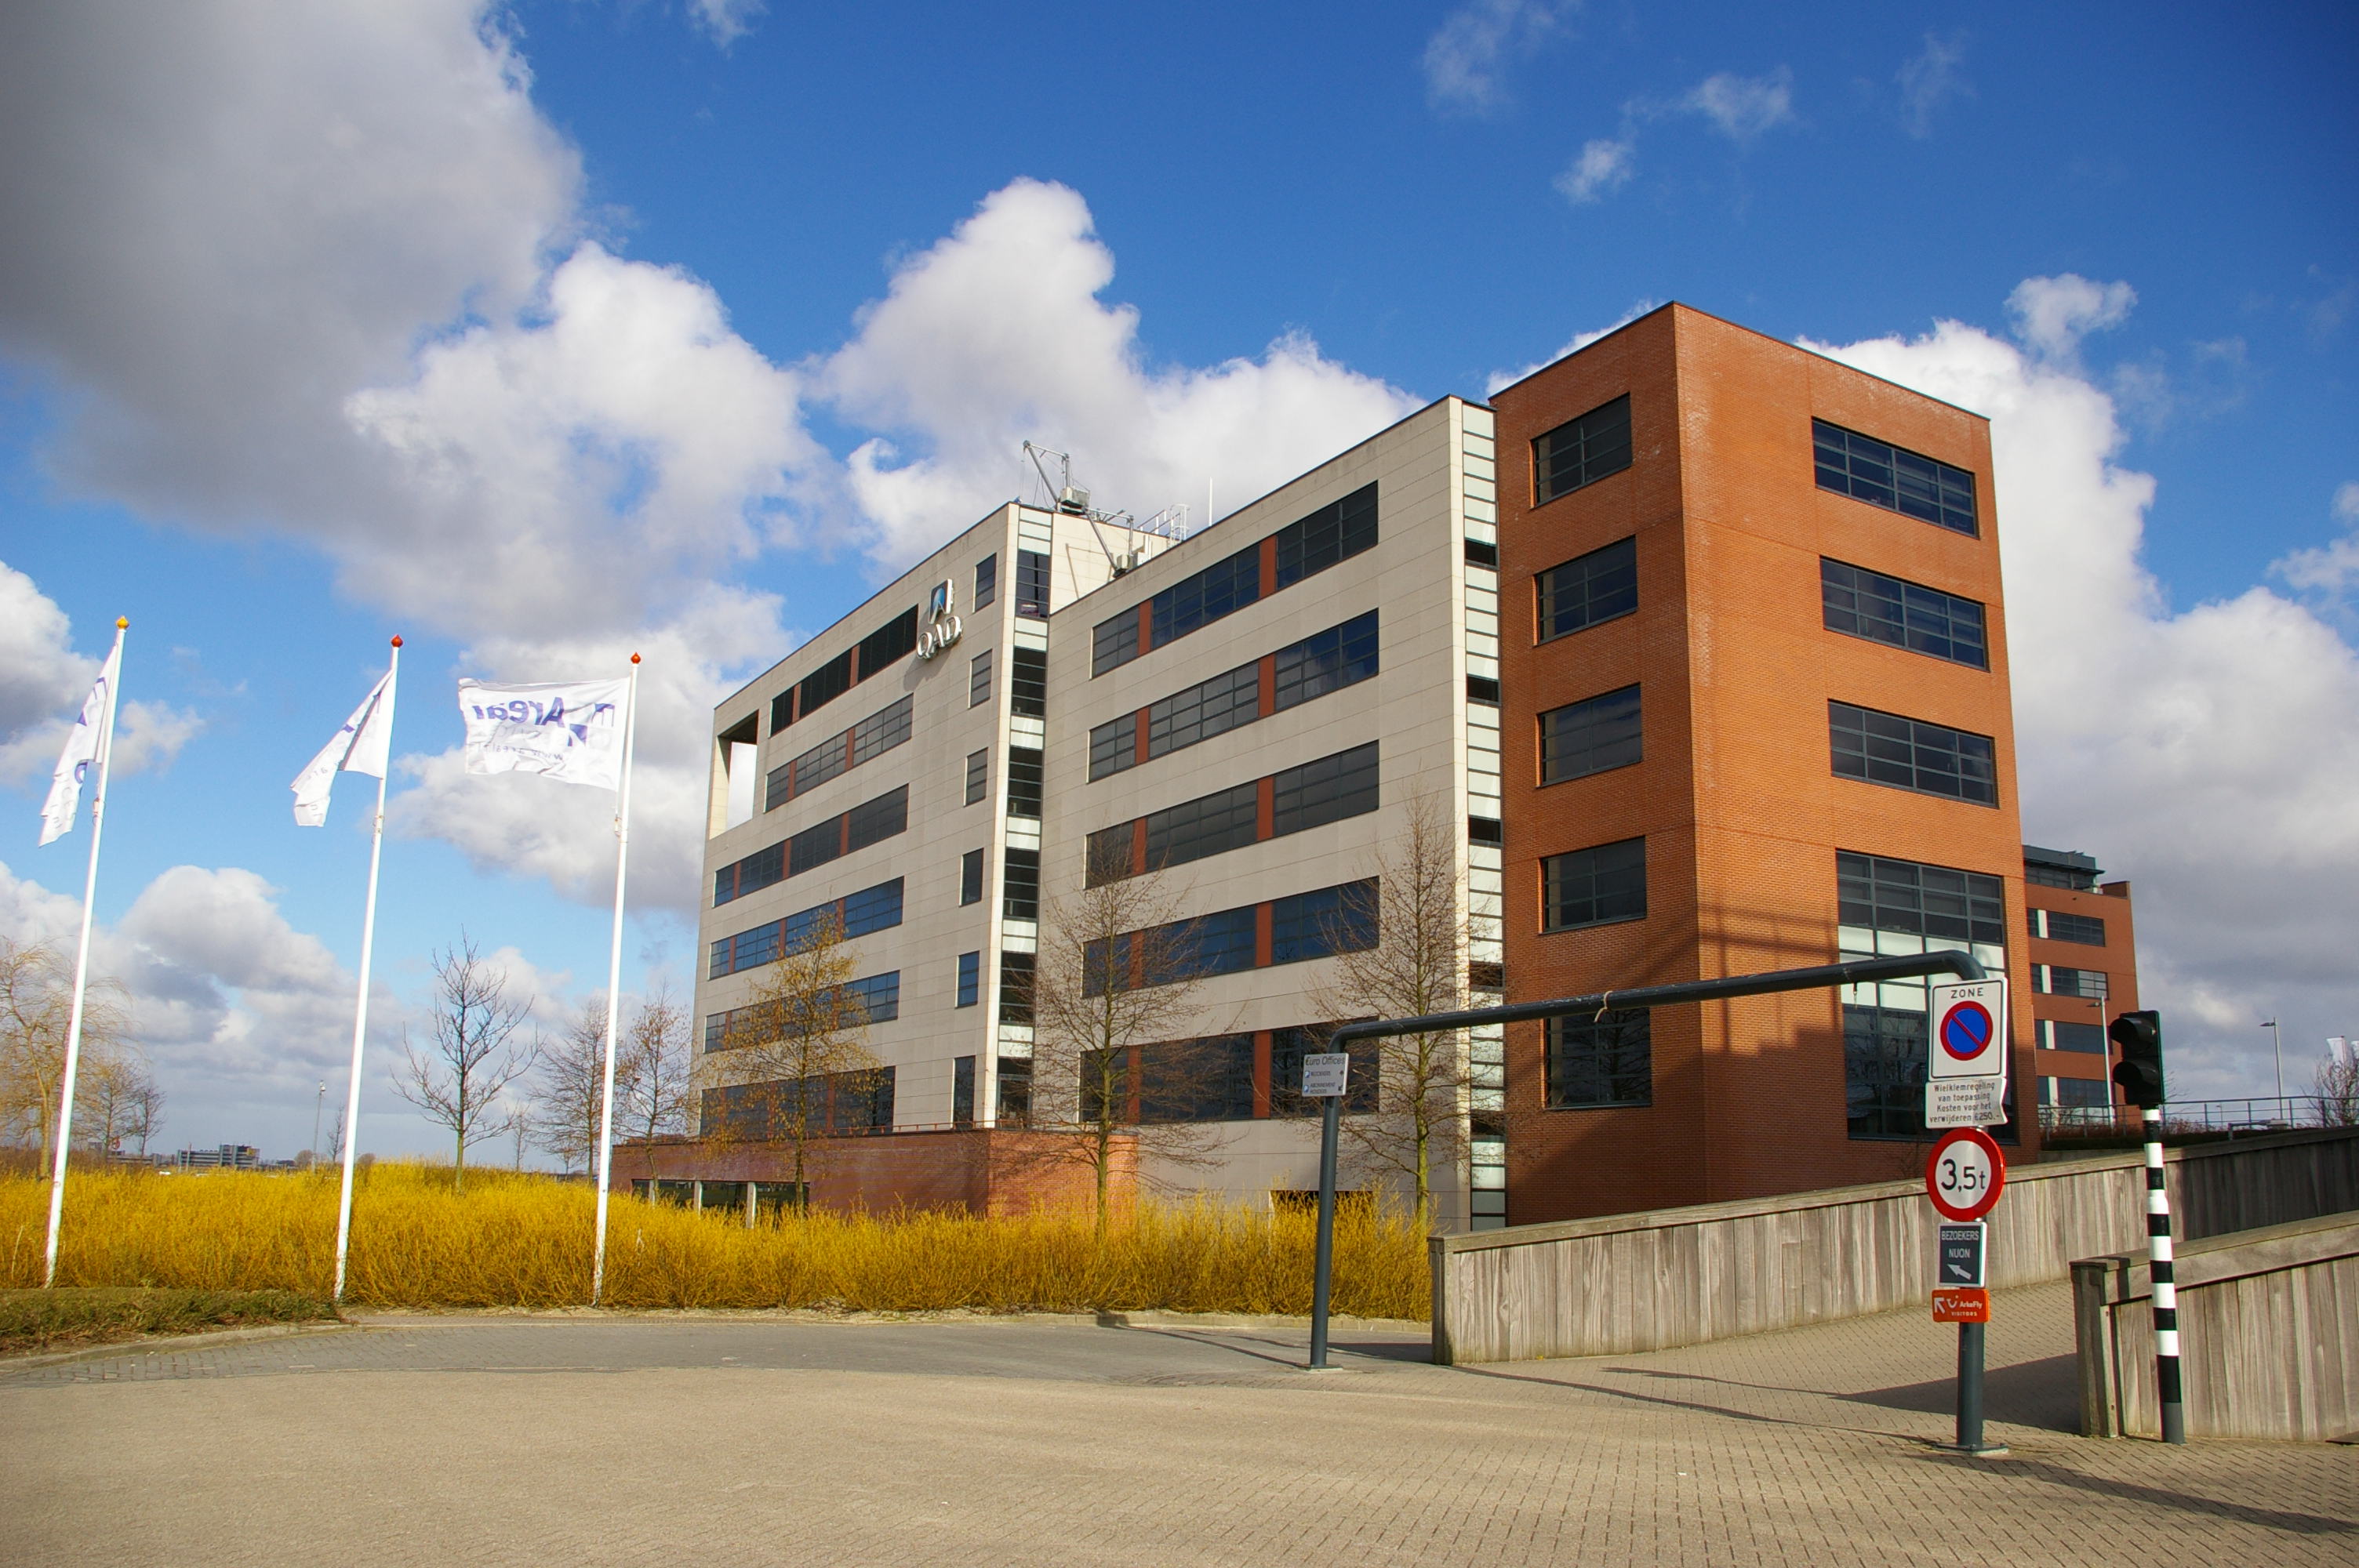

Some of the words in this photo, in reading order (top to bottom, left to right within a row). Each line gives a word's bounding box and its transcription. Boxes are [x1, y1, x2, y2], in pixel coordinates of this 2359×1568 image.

[918, 615, 963, 659] QAD
[1950, 987, 1983, 999] ZONE
[1934, 1082, 1995, 1093] Wielklemregeling
[1953, 1091, 1990, 1102] toepassing
[1980, 1102, 1992, 1110] het
[1929, 1114, 1972, 1124] verwijderen
[1941, 1230, 1979, 1241] BEZOEKERS
[1948, 1247, 1971, 1258] NUON
